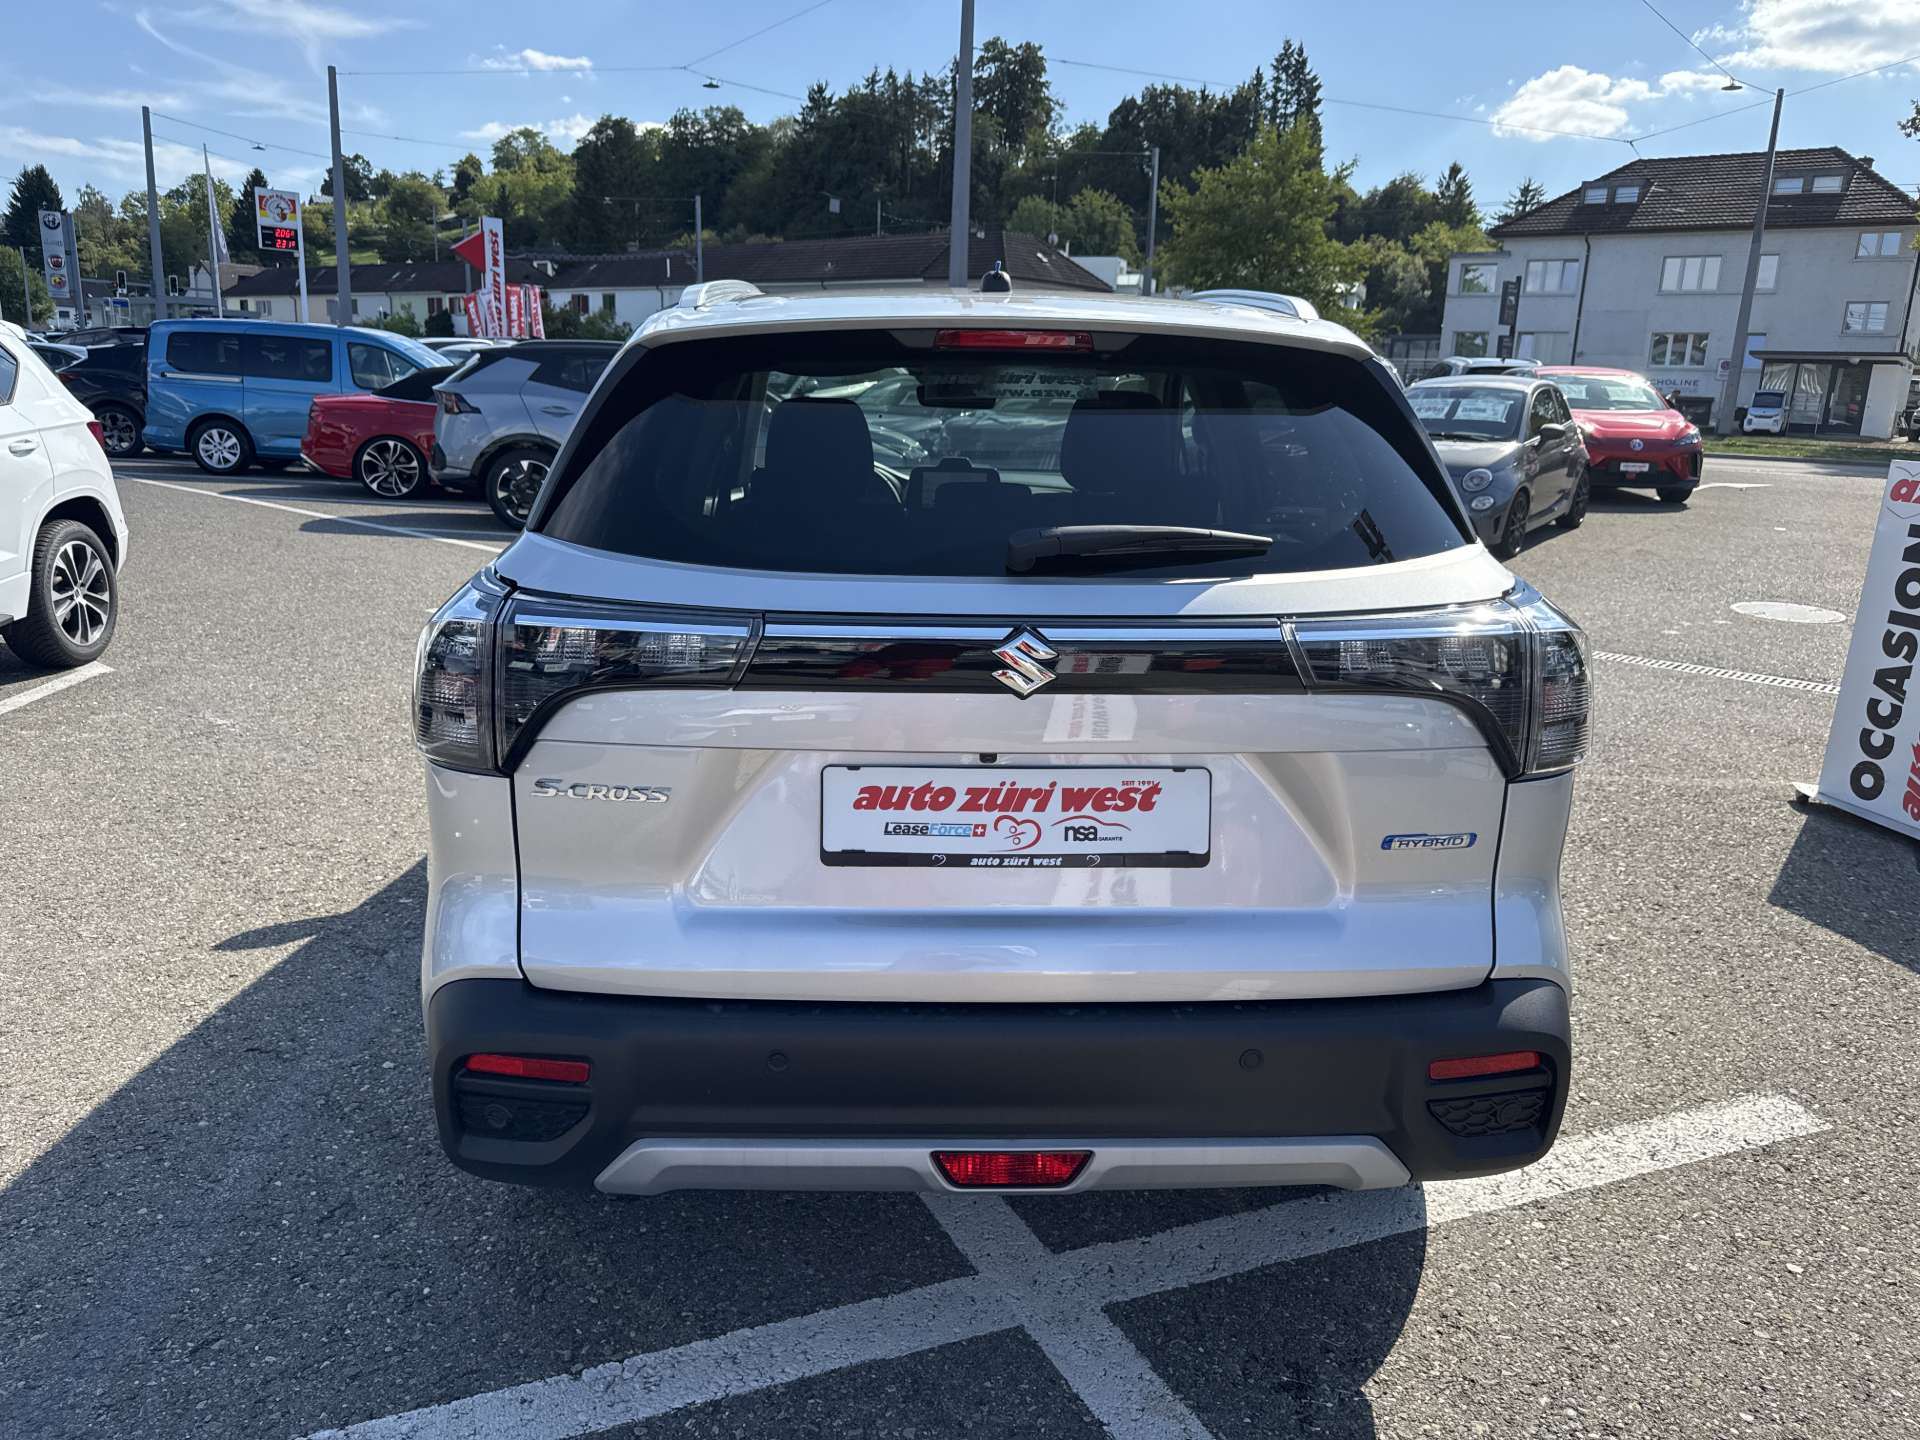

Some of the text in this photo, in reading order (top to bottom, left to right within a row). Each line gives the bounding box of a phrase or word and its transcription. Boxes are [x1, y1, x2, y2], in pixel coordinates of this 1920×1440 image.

[530, 777, 673, 804] S-CROSS
[852, 780, 1163, 812] auto züri west
[883, 821, 972, 836] LeaseForce
[1063, 825, 1098, 842] nsa
[1396, 836, 1464, 848] HYBRID
[970, 856, 1063, 866] auto züri west
